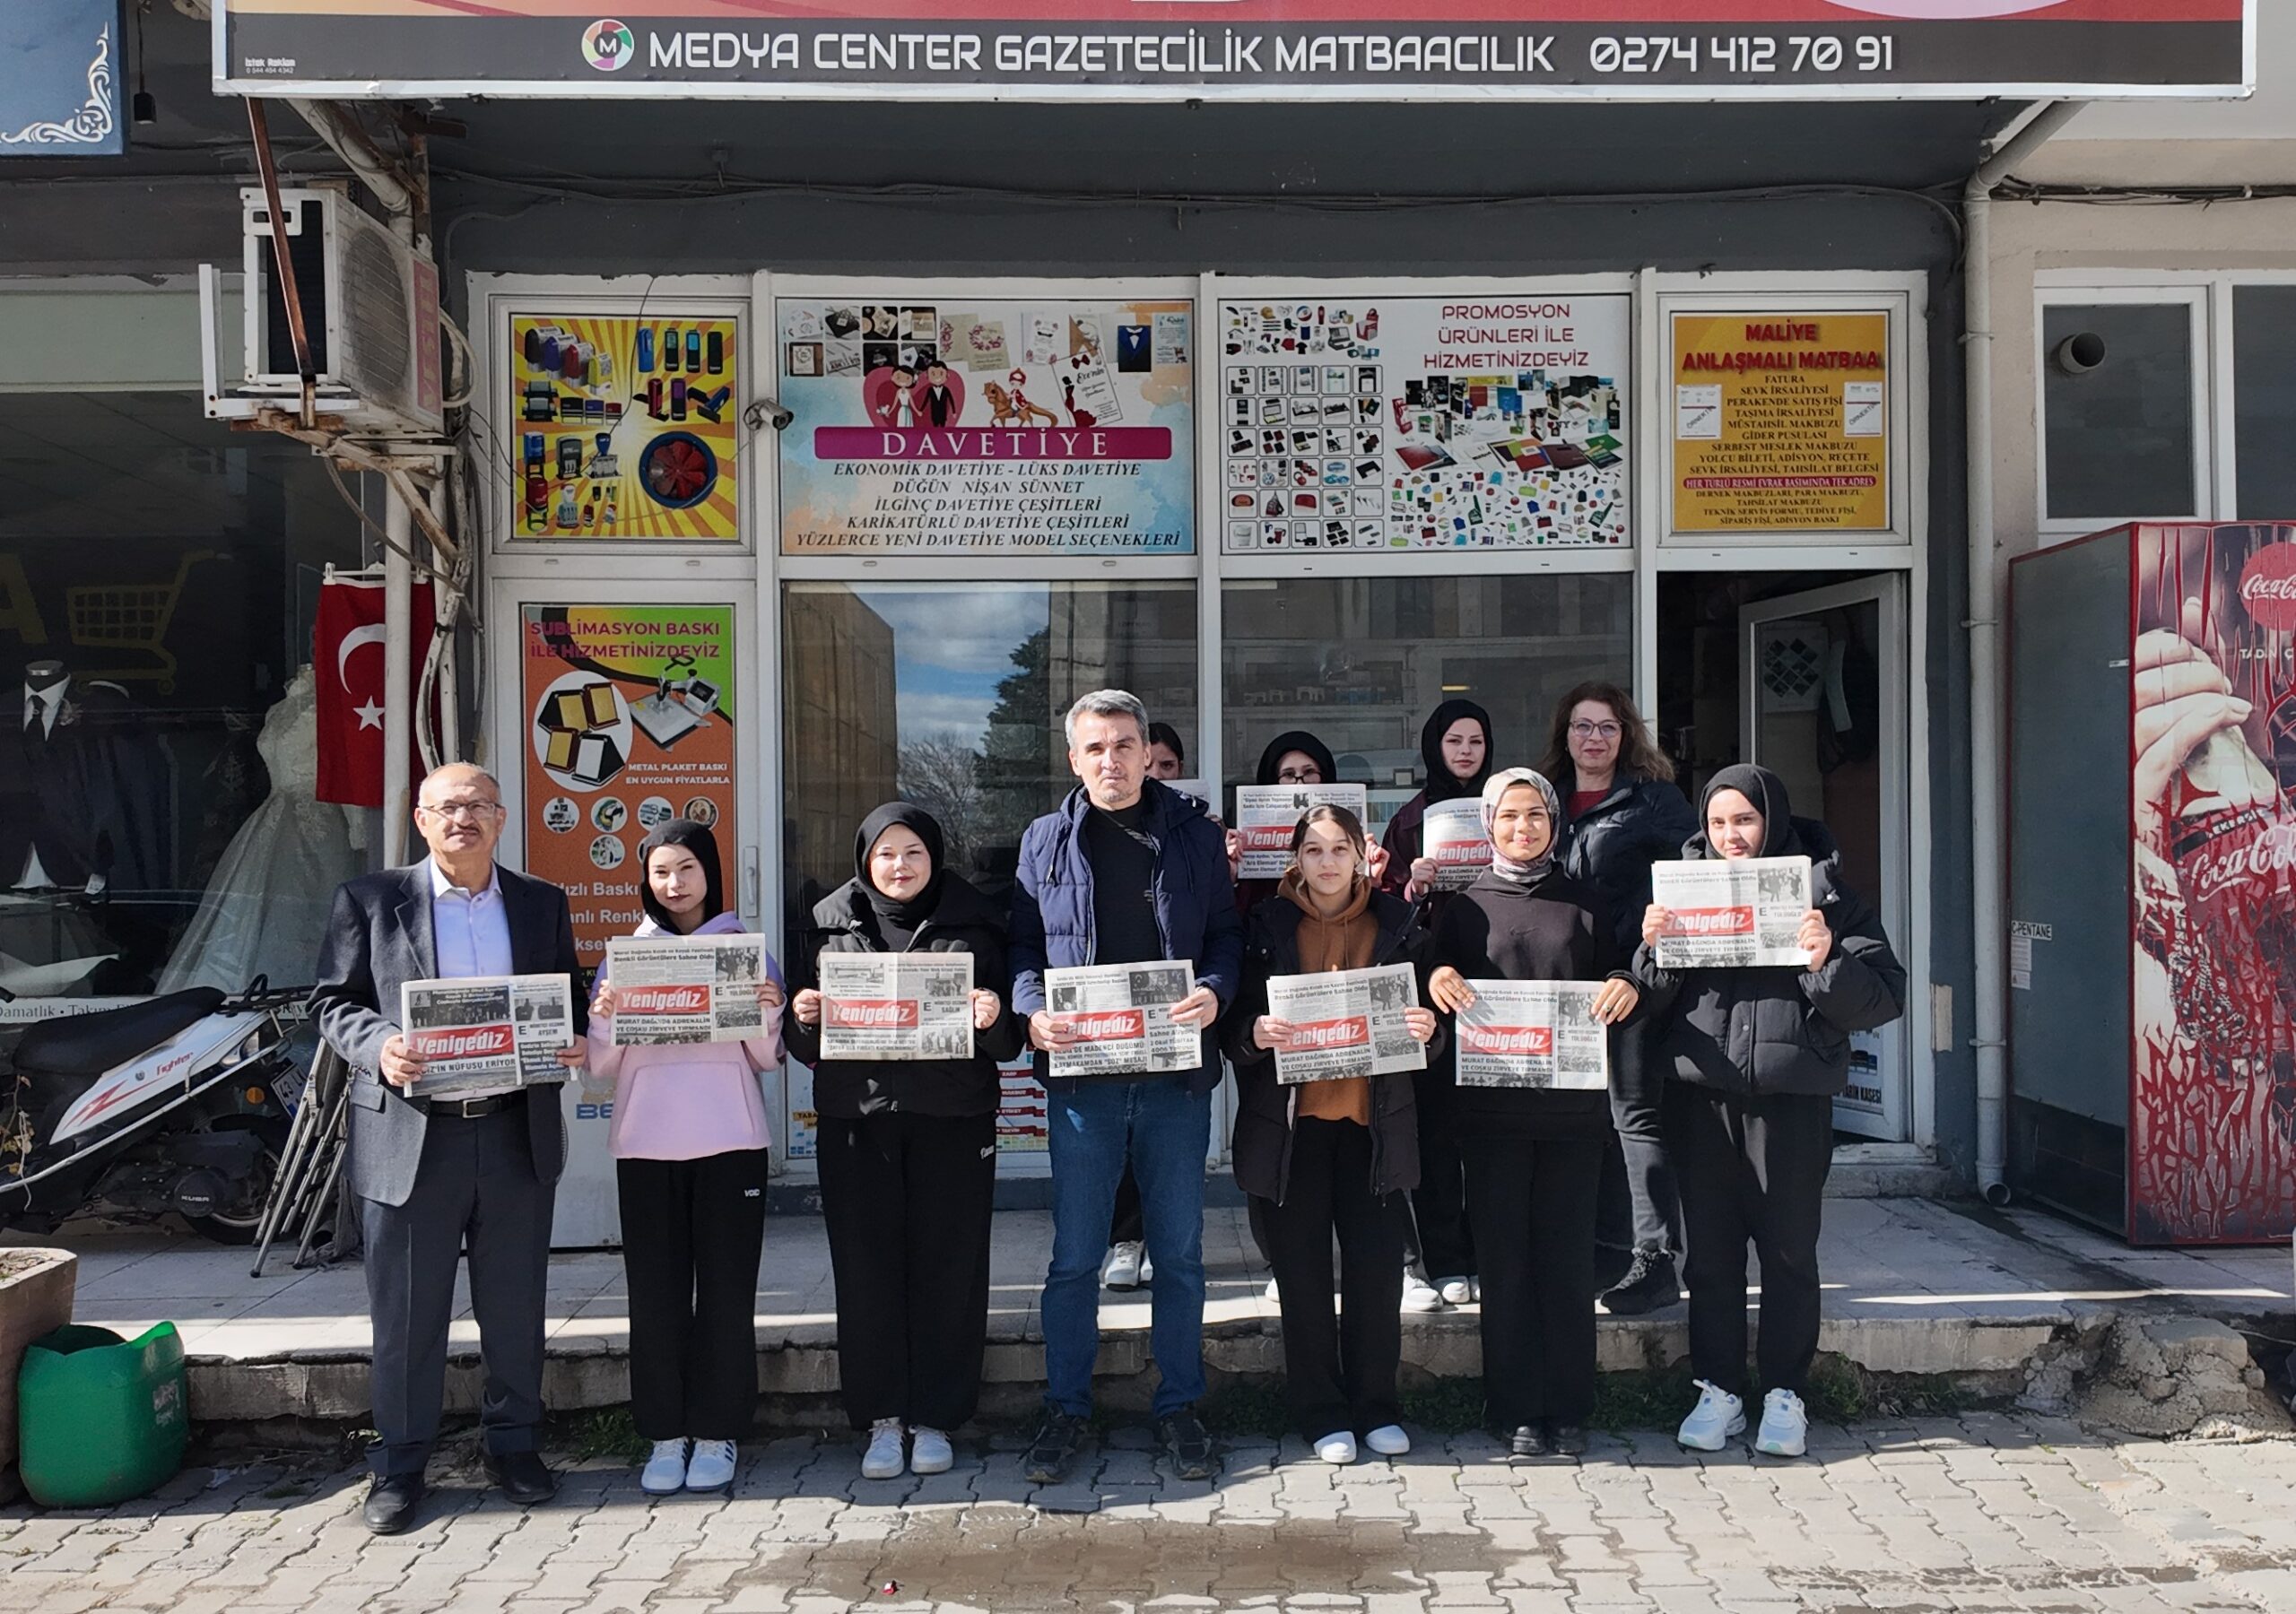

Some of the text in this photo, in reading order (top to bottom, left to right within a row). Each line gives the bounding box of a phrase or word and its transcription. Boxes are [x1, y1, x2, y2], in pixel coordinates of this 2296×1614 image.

[650, 28, 1892, 72] MEDYA CENTER GAZETECİLİK MATBAACILIK 0274 412 70 91
[1442, 304, 1570, 320] PROMOSYON
[1439, 325, 1574, 344] ÜRÜNLERİ İLE
[1745, 319, 1817, 341] MALİYE
[1424, 351, 1588, 369] HİZMETİNİZDEYİZ
[1682, 351, 1880, 374] ANLAŞMALI MATBAA
[1790, 420, 1841, 428] MAKBUZU
[883, 428, 1109, 456] DAVETİYE
[1742, 431, 1775, 440] GİDER
[1805, 442, 1857, 450] MAKBUZU
[834, 462, 1141, 476] EKONOMİK DAVETİYE LÜKS DAVETİYE
[892, 479, 1084, 495] DÜĞÜN NİŞAN SÜNNET
[875, 497, 1101, 514] İLGİNÇ DAVETİYE ÇEŞİTLERİ
[848, 515, 1128, 531] KARİKATÜRLÜ DAVETİYE ÇEŞİTLERİ
[796, 532, 1180, 549] YÜZLERCE YENİ DAVETİYE MODEL SEÇENEKLERİ
[531, 618, 719, 636] SUBLİMASYON BASKI
[531, 640, 719, 658] İLE HİZMETİNİZDEYİZ
[628, 763, 659, 771] METAL
[661, 763, 697, 771] PLAKET
[674, 775, 730, 784] FİYATLARLA
[1247, 831, 1293, 846] Yenige
[593, 881, 639, 896] Baskı
[2011, 924, 2052, 938] C-PENTANE
[622, 991, 700, 1010] Yenigediz
[831, 1003, 909, 1022] Yenigediz
[1068, 1015, 1135, 1037] enigediz
[415, 1031, 503, 1055] Yenigediz
[1292, 1024, 1360, 1046] enigediz
[1467, 1032, 1544, 1050] Yenigediz
[485, 1058, 517, 1068] ERİYOR
